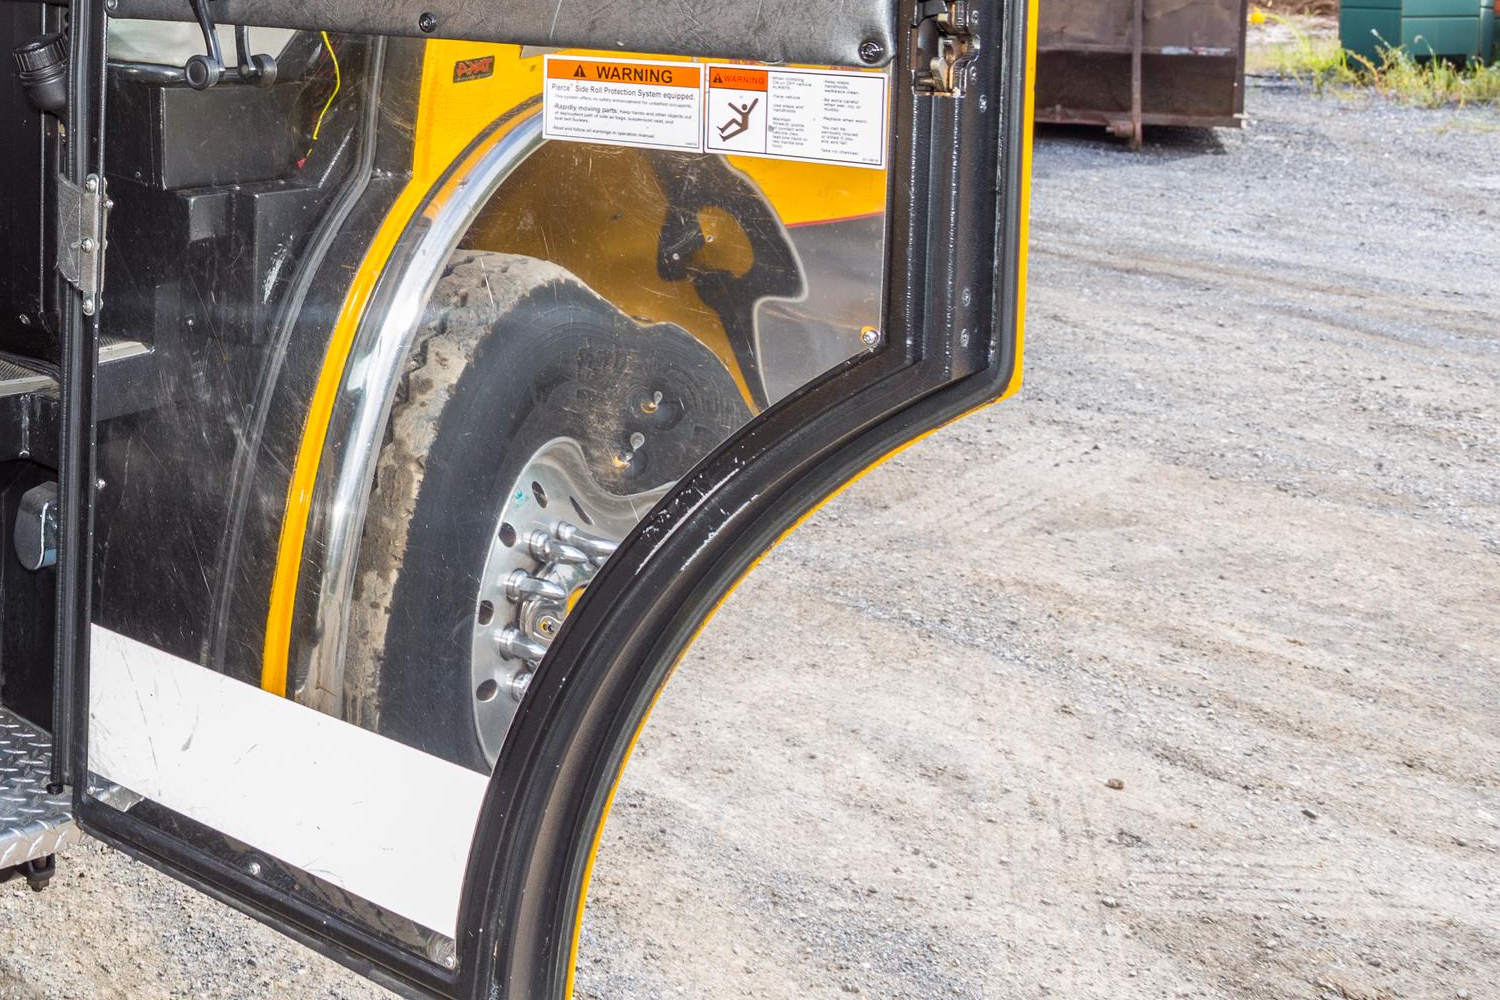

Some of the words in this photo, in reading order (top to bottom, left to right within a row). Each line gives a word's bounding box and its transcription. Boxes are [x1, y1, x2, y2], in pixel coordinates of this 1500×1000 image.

[596, 65, 673, 84] WARNING
[724, 74, 765, 85] WARNING
[575, 85, 589, 93] Side
[590, 86, 603, 94] Roll
[604, 87, 636, 96] Protection
[638, 89, 661, 99] System
